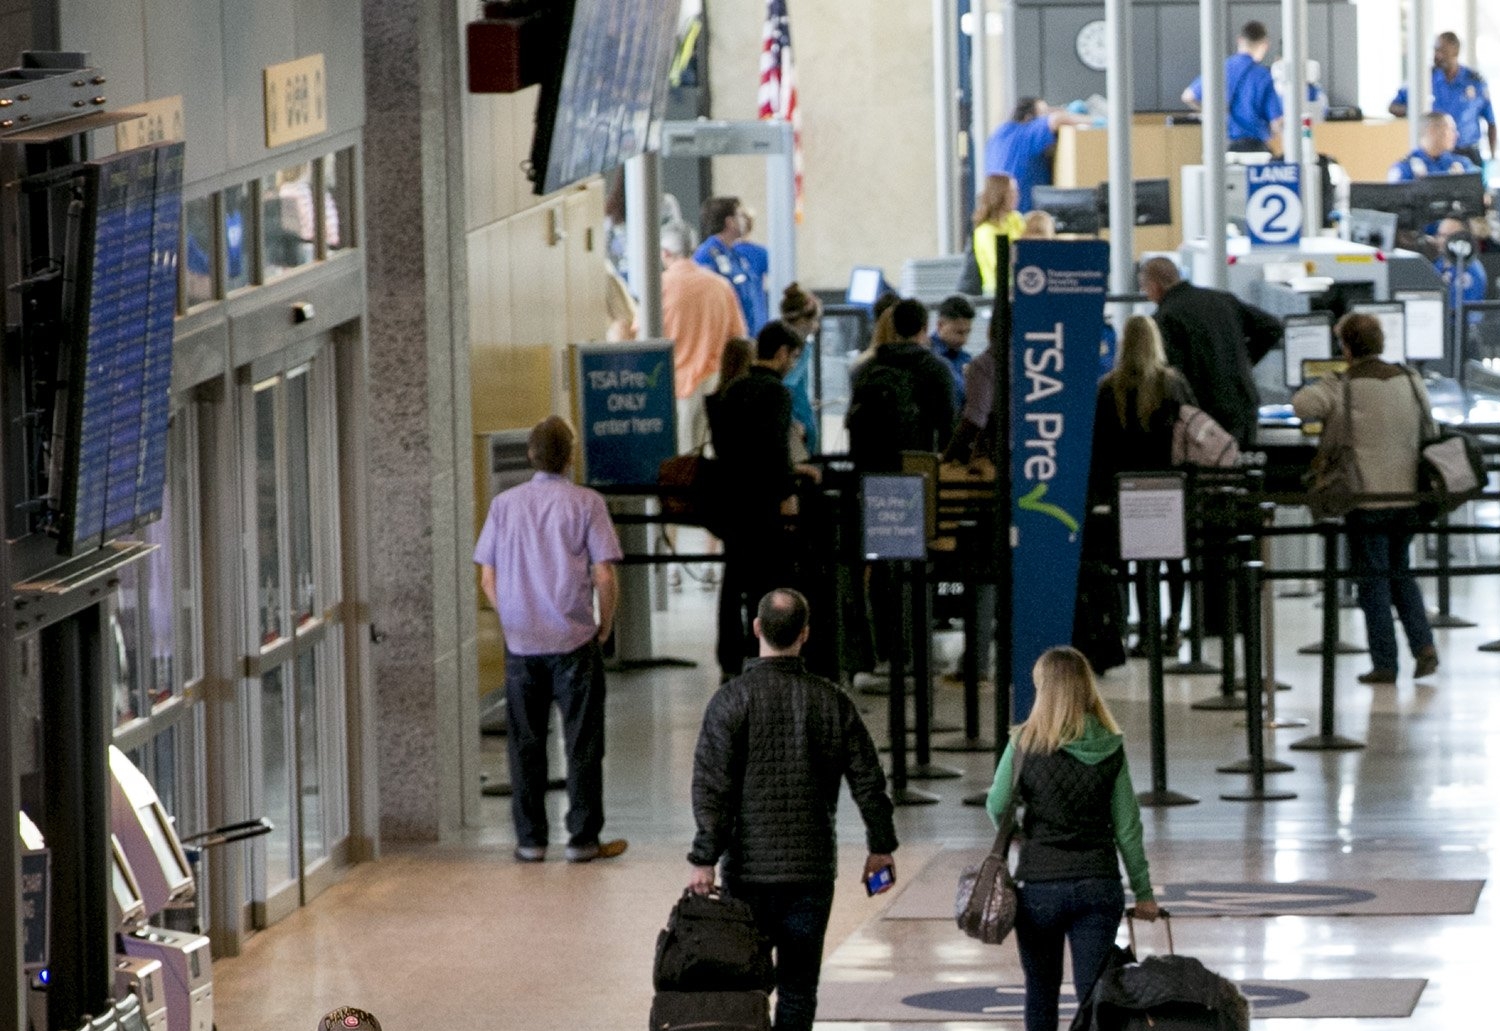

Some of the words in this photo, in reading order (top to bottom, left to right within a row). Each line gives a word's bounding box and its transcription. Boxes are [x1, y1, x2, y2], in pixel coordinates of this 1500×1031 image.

[1249, 166, 1298, 182] LANE
[1262, 194, 1287, 232] 2
[1024, 322, 1063, 403] TSA
[588, 369, 617, 389] TSA
[619, 369, 647, 389] Pre
[607, 392, 647, 412] ONLY
[593, 420, 630, 436] enter
[631, 416, 664, 435] here
[1024, 413, 1063, 480] Pre
